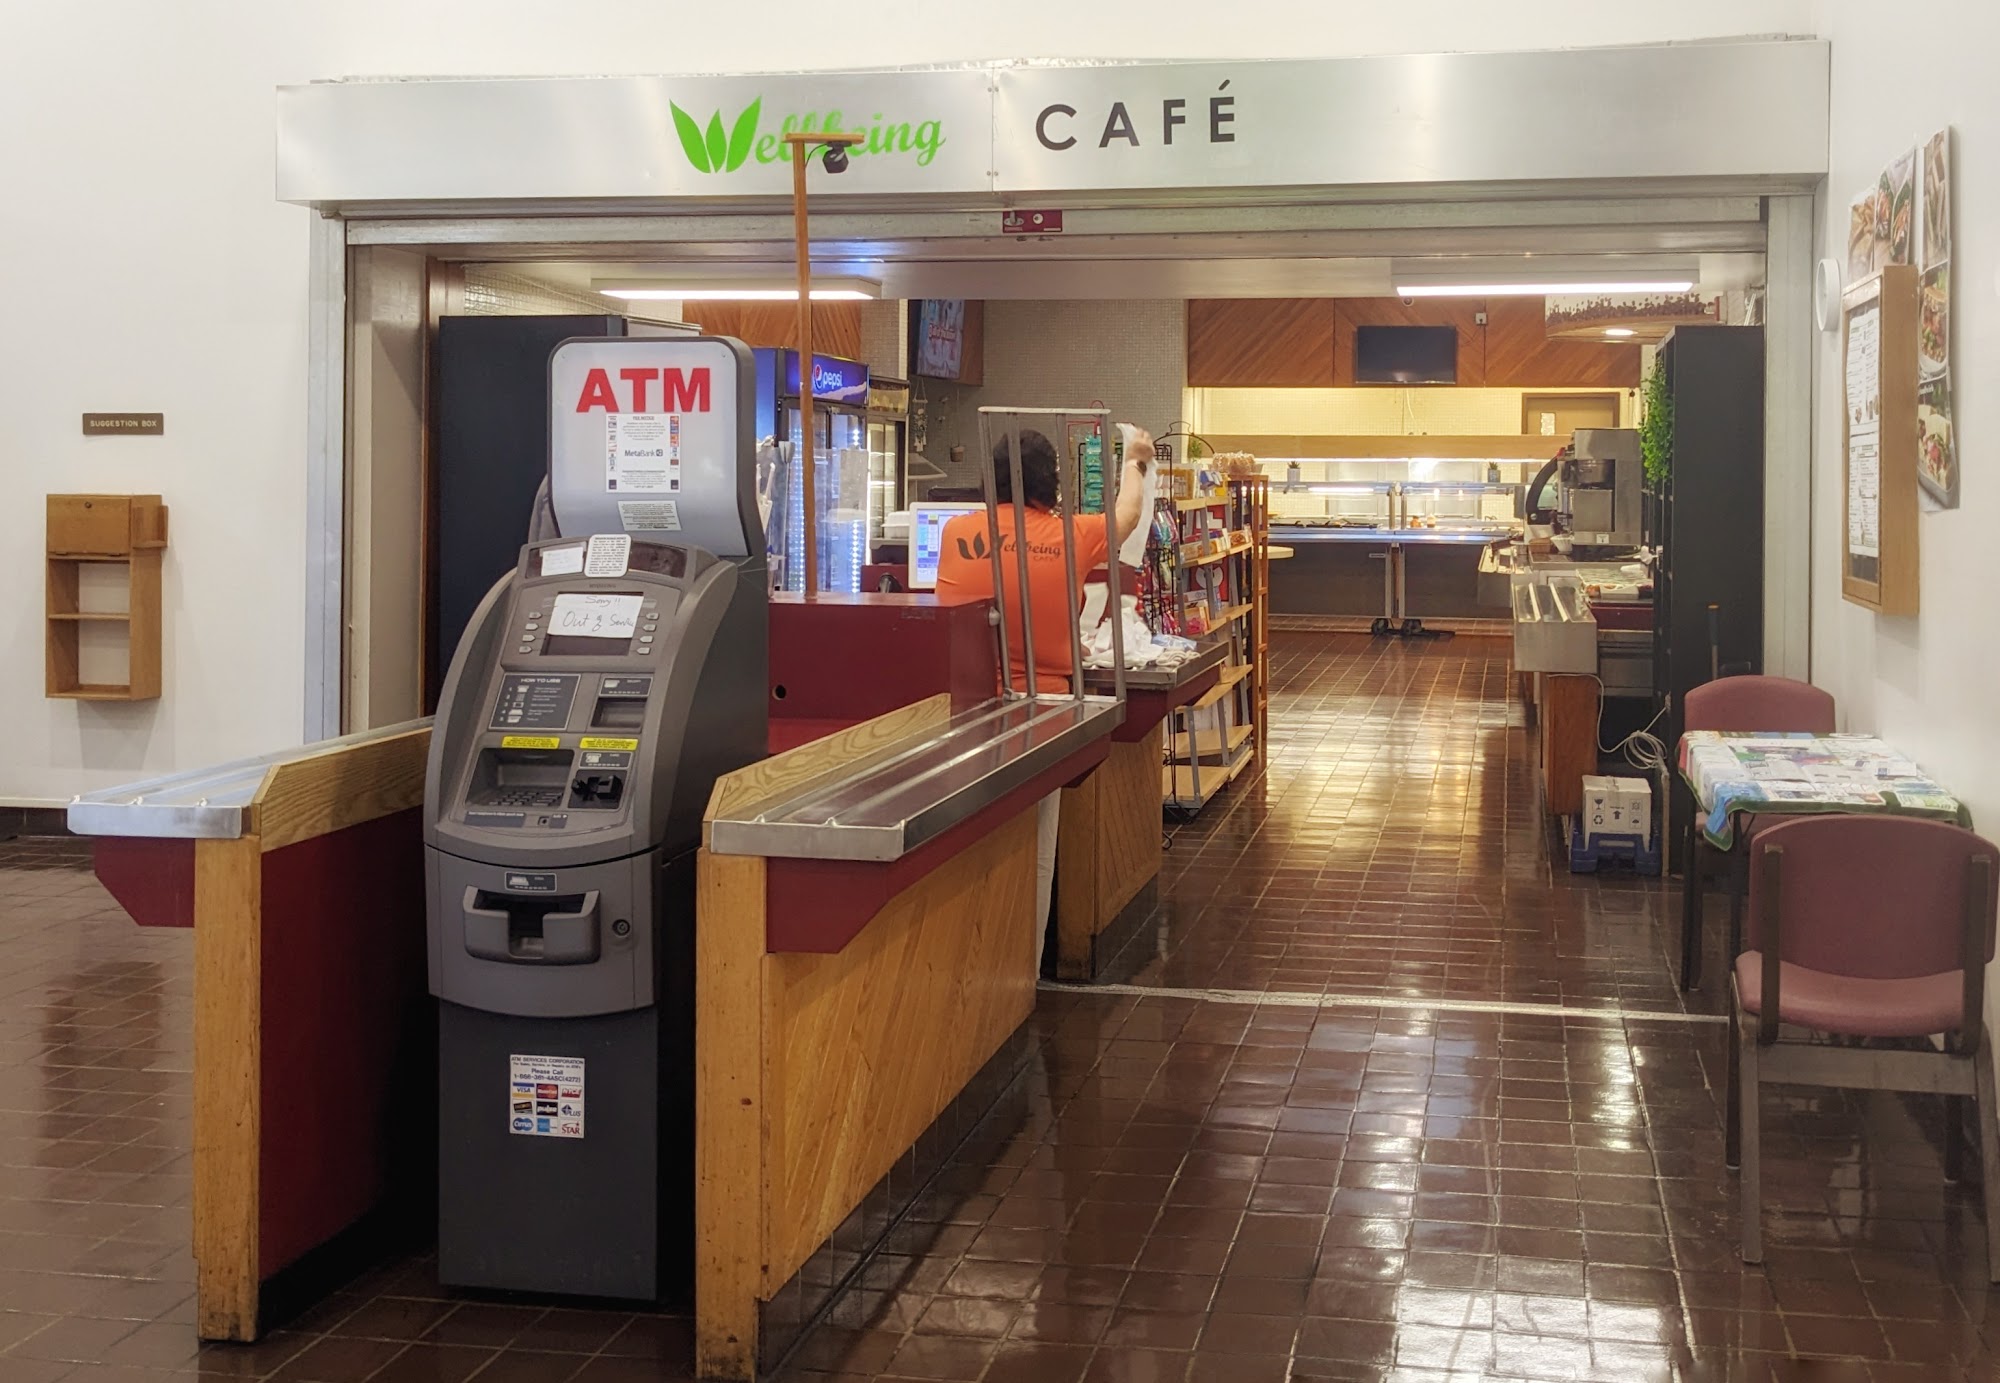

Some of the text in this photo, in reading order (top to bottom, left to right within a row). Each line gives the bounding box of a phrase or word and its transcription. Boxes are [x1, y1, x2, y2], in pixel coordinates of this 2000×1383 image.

[1035, 80, 1235, 151] CAFÉ
[823, 370, 843, 390] pepsi
[576, 367, 711, 413] ATM
[142, 419, 157, 427] BOX
[624, 449, 655, 457] MetaBank
[562, 610, 590, 628] Out
[514, 1120, 532, 1128] Cirrus
[562, 1126, 580, 1135] STAR
